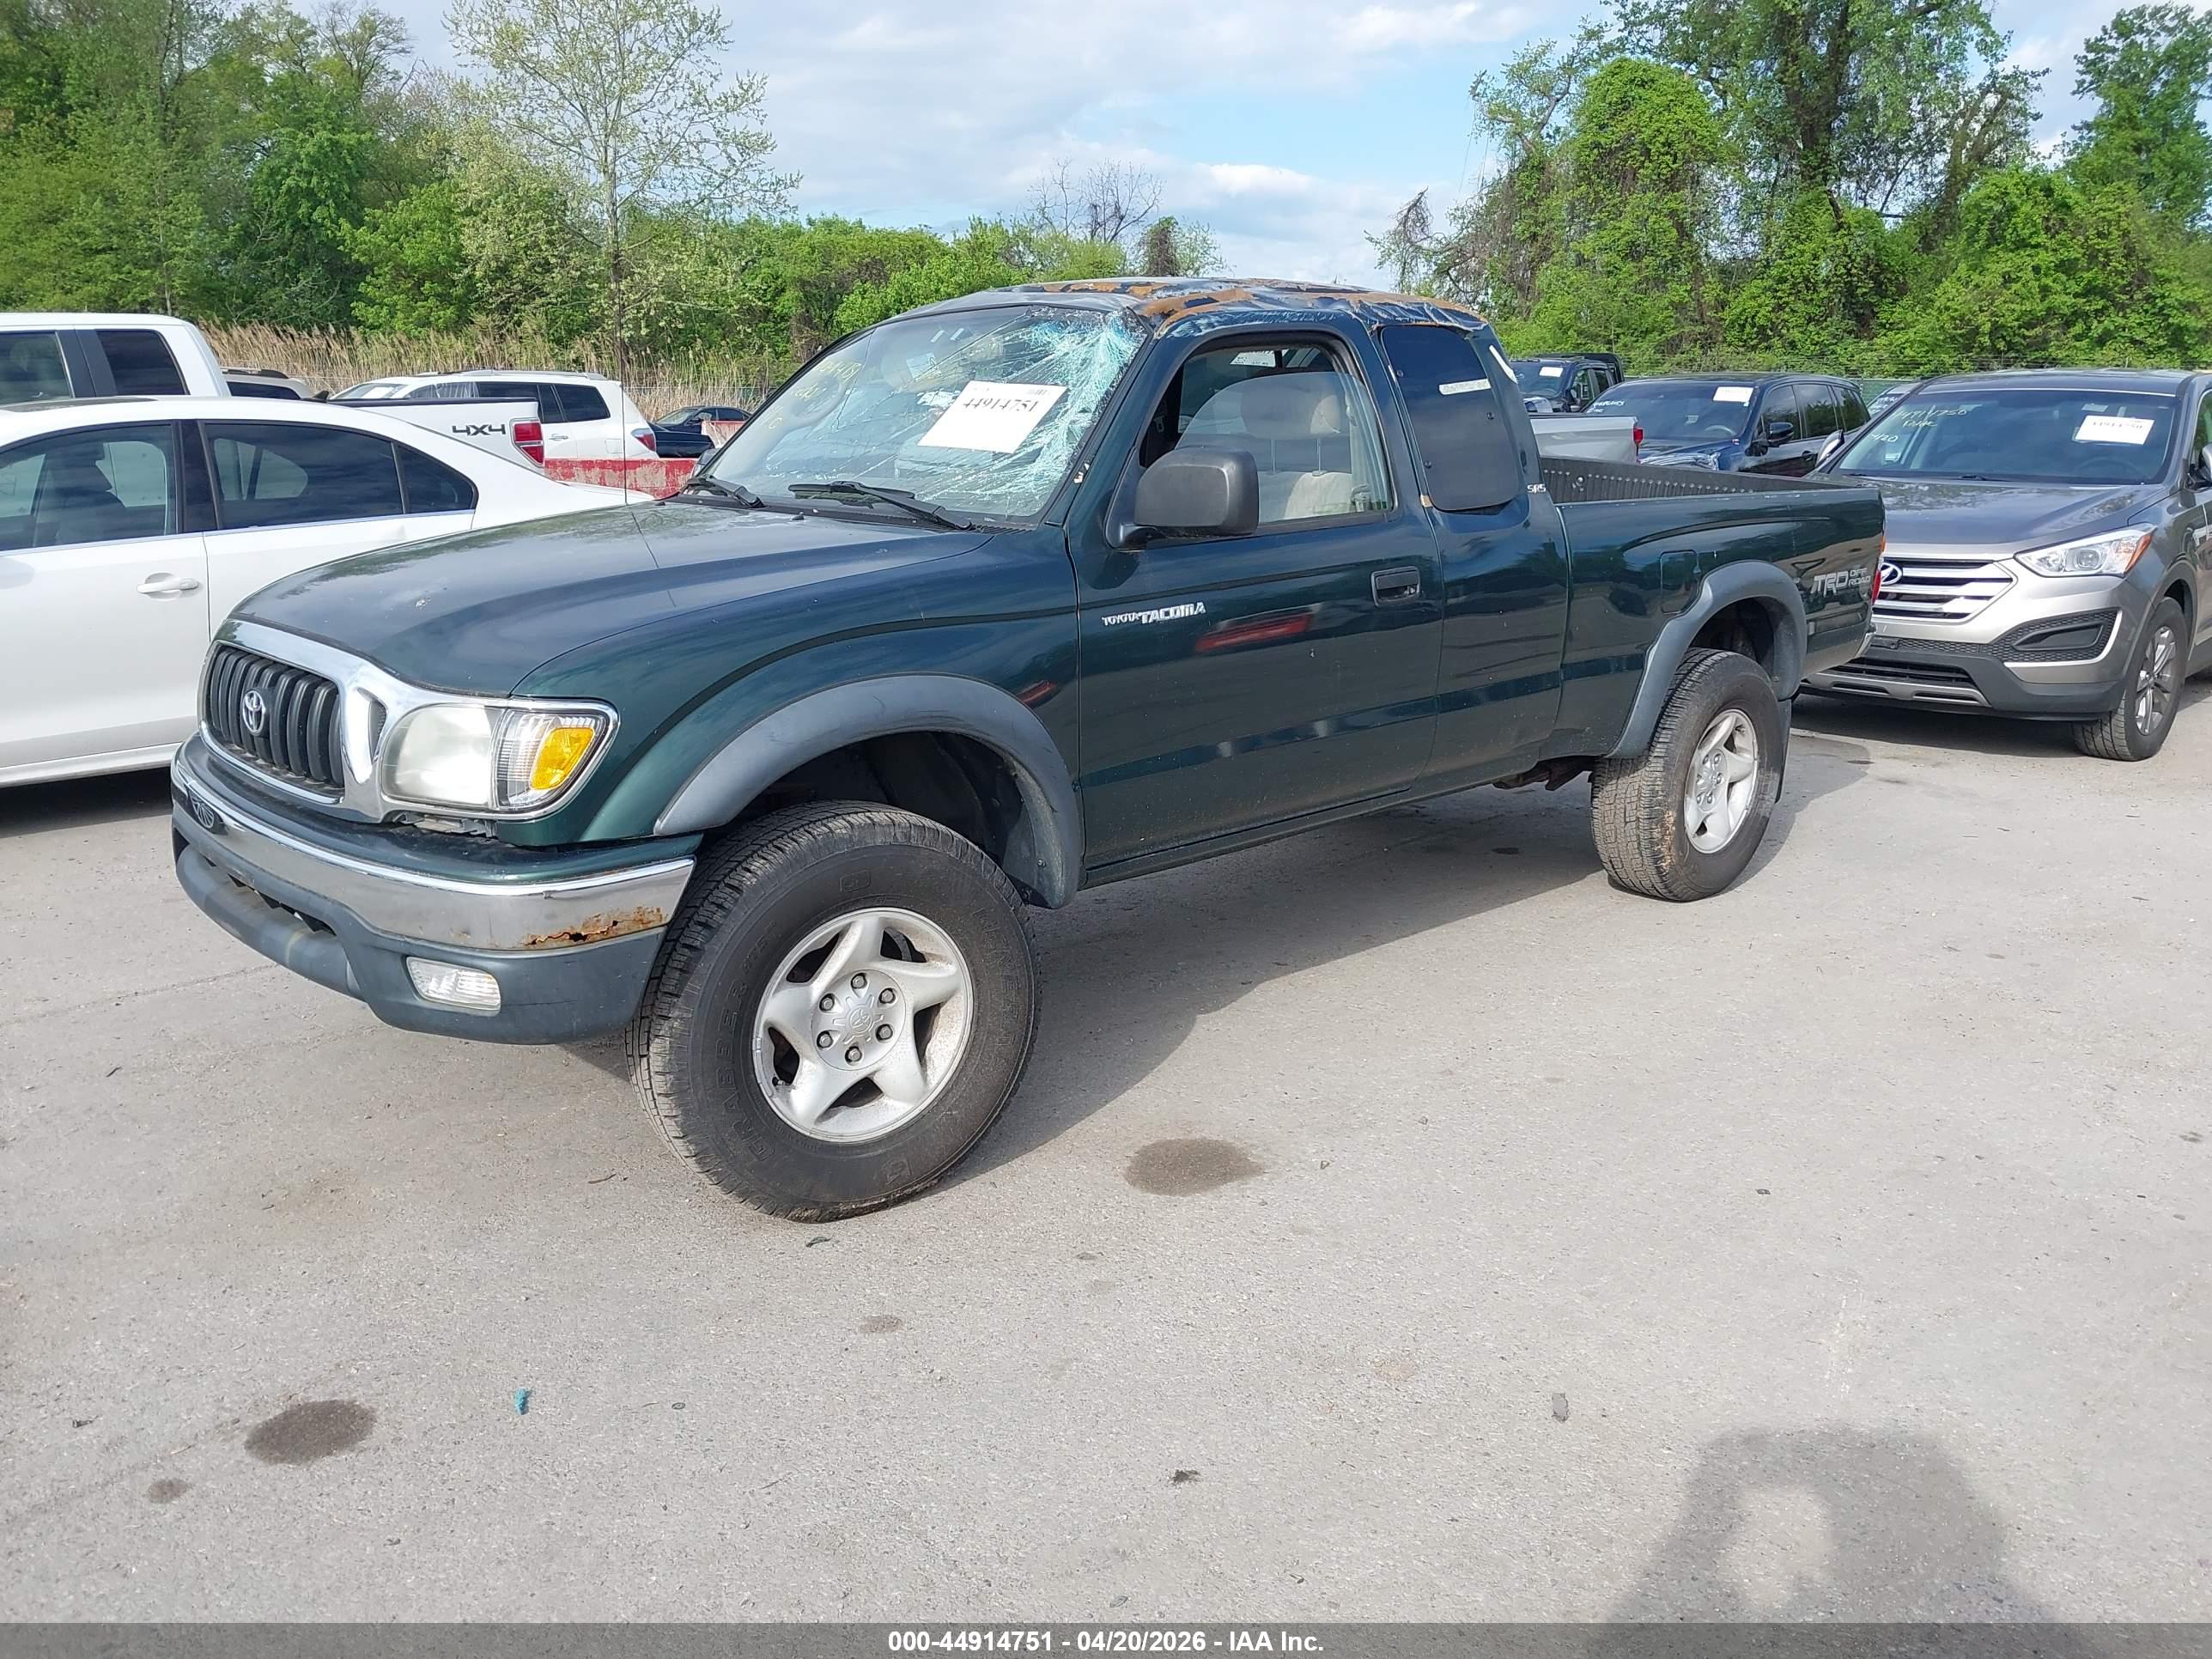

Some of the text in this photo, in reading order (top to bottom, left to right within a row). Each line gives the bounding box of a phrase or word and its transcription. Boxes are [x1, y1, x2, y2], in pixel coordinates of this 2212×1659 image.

[963, 398, 1040, 412] 44914751
[1849, 568, 1869, 577] OFF
[1810, 570, 1849, 598] TRD
[1101, 601, 1206, 626] TOYOTA TACOMA
